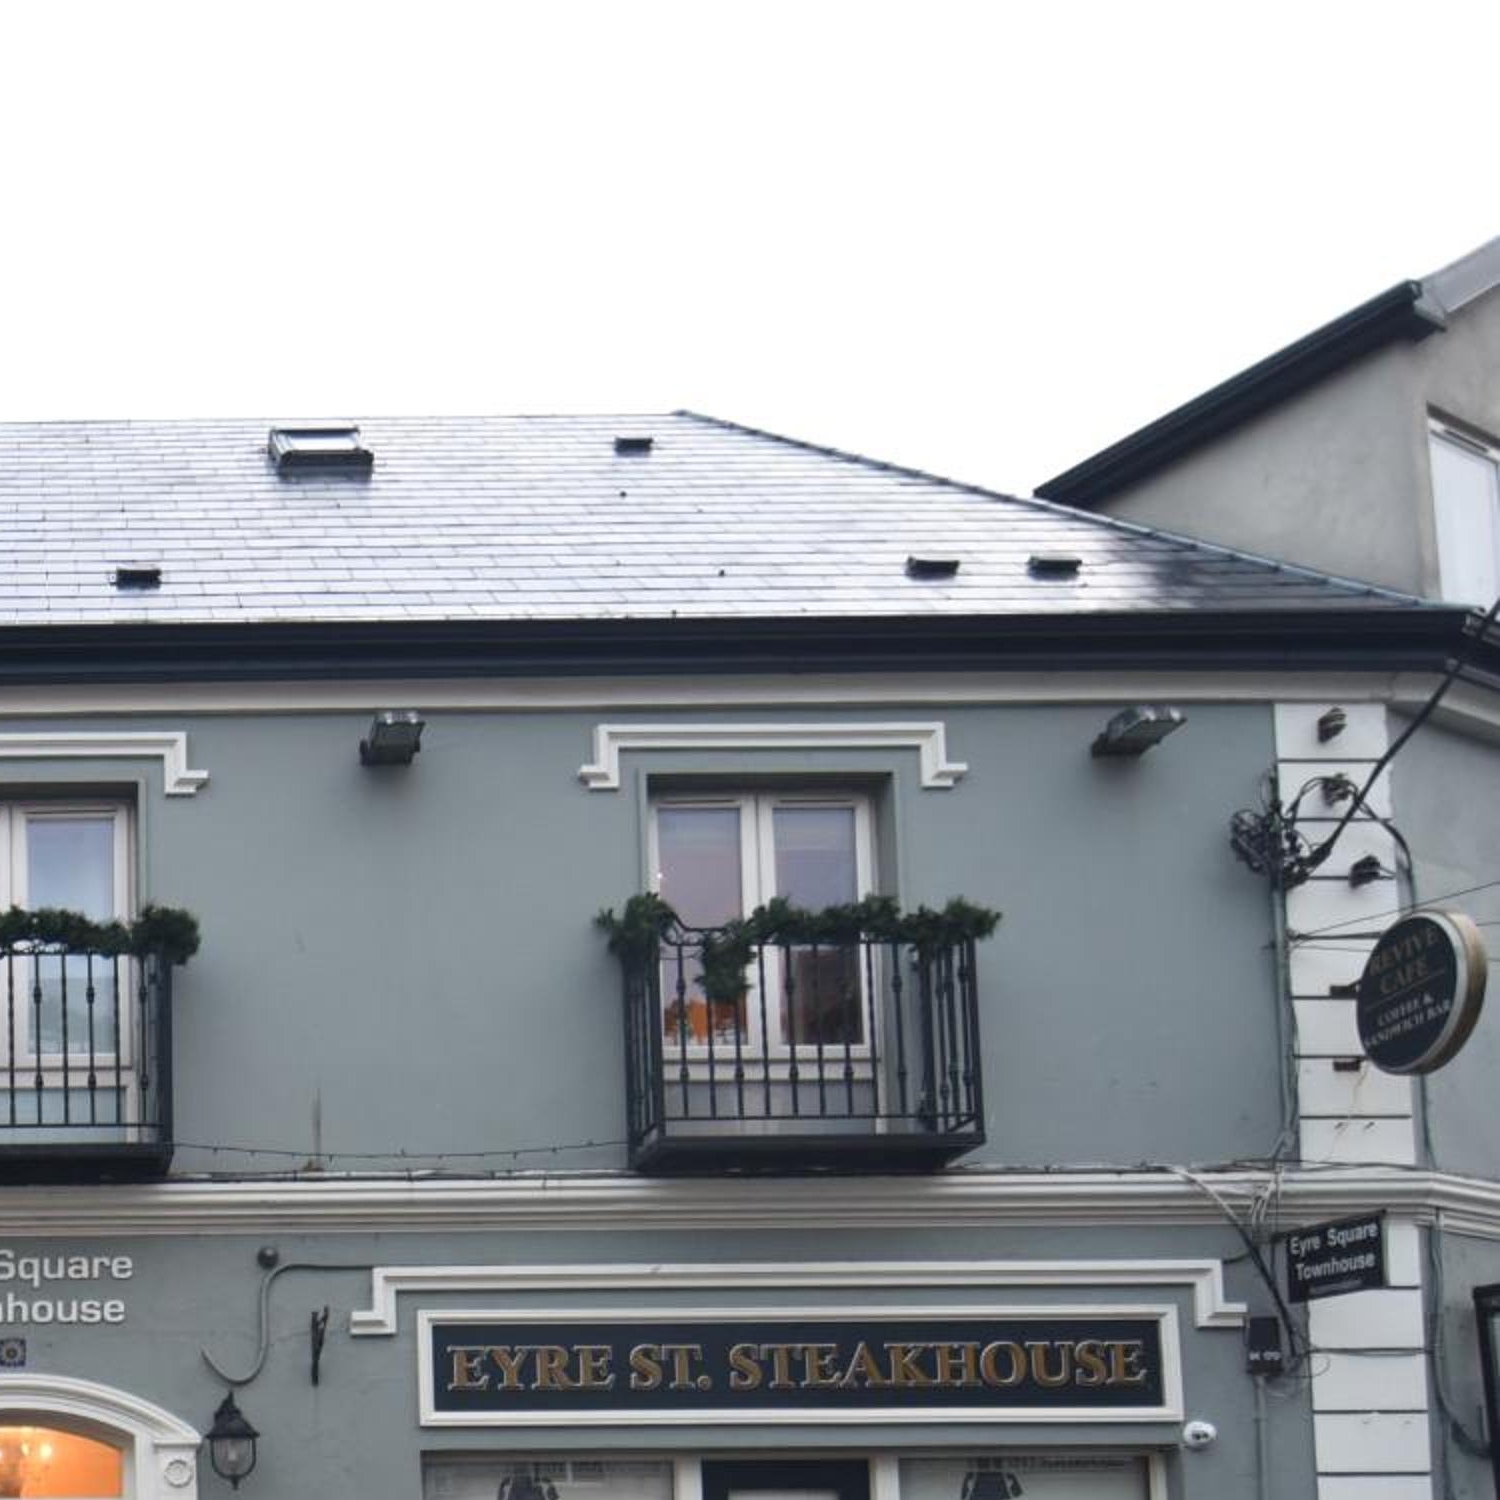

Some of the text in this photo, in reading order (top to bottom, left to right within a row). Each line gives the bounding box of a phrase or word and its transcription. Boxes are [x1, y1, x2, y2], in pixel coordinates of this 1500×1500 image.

[1369, 928, 1441, 977] REVIVE
[1379, 958, 1428, 993] CAFE
[1364, 999, 1451, 1050] SANDWICH BAR
[1377, 998, 1420, 1027] COFFEE
[1290, 1222, 1378, 1257] Eyre Square
[1295, 1252, 1375, 1281] Townhouse
[446, 1339, 1148, 1391] EYRE ST. STEAKHOUSE
